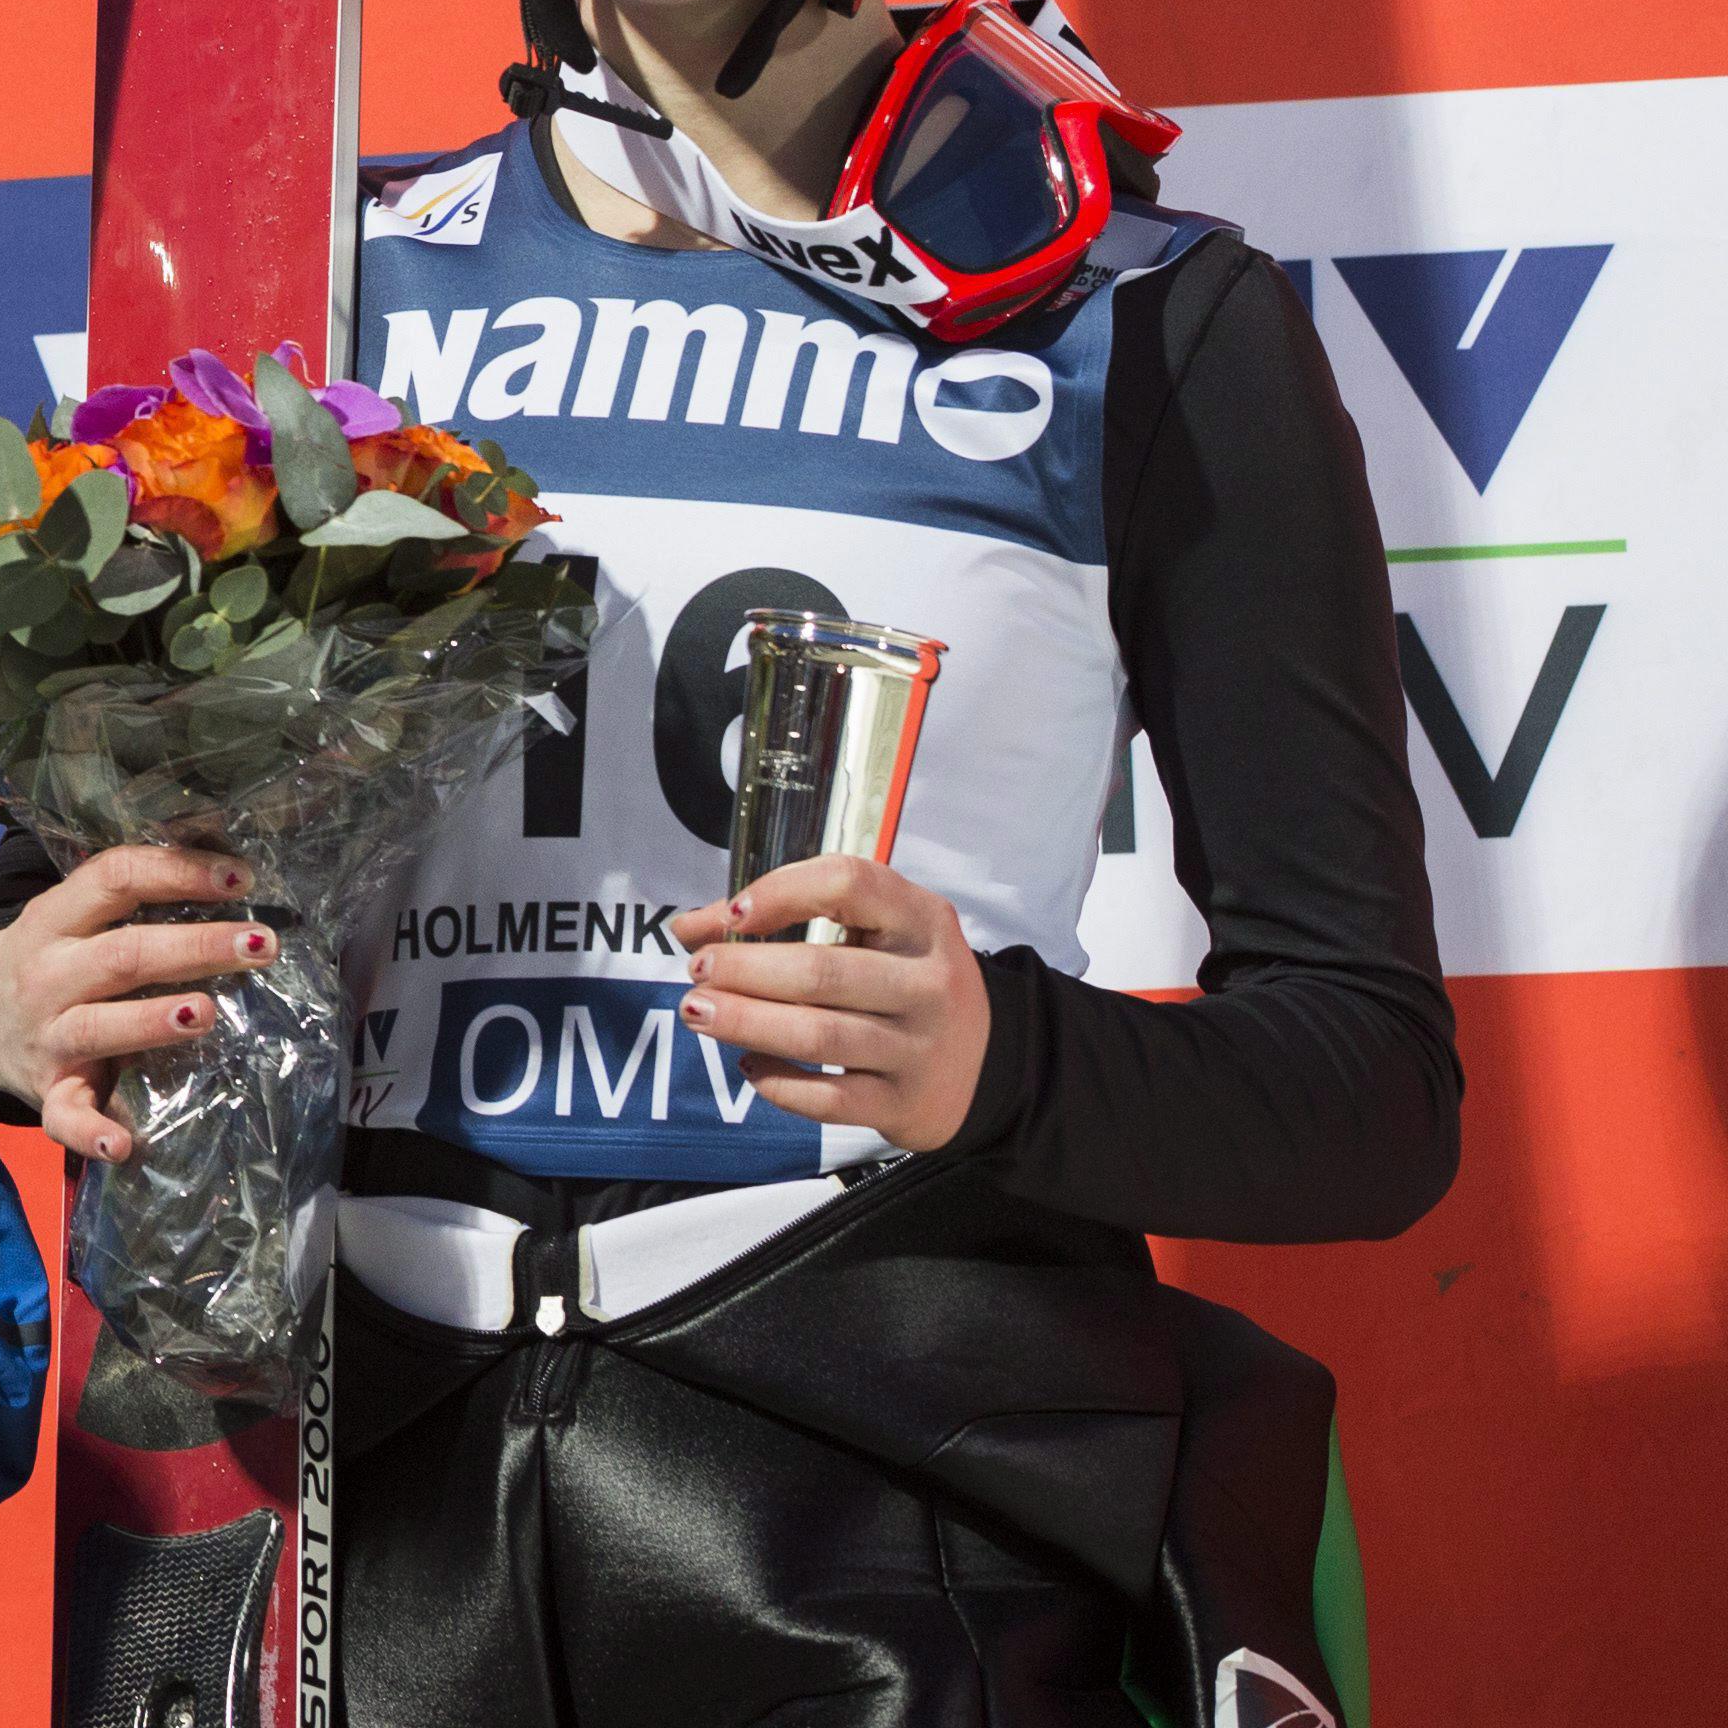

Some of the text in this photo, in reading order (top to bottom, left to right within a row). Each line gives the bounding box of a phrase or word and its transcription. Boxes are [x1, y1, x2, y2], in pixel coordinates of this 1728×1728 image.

[729, 209, 917, 287] uvex
[392, 901, 692, 963] HOLMENK
[300, 1512, 331, 1728] SPORT
